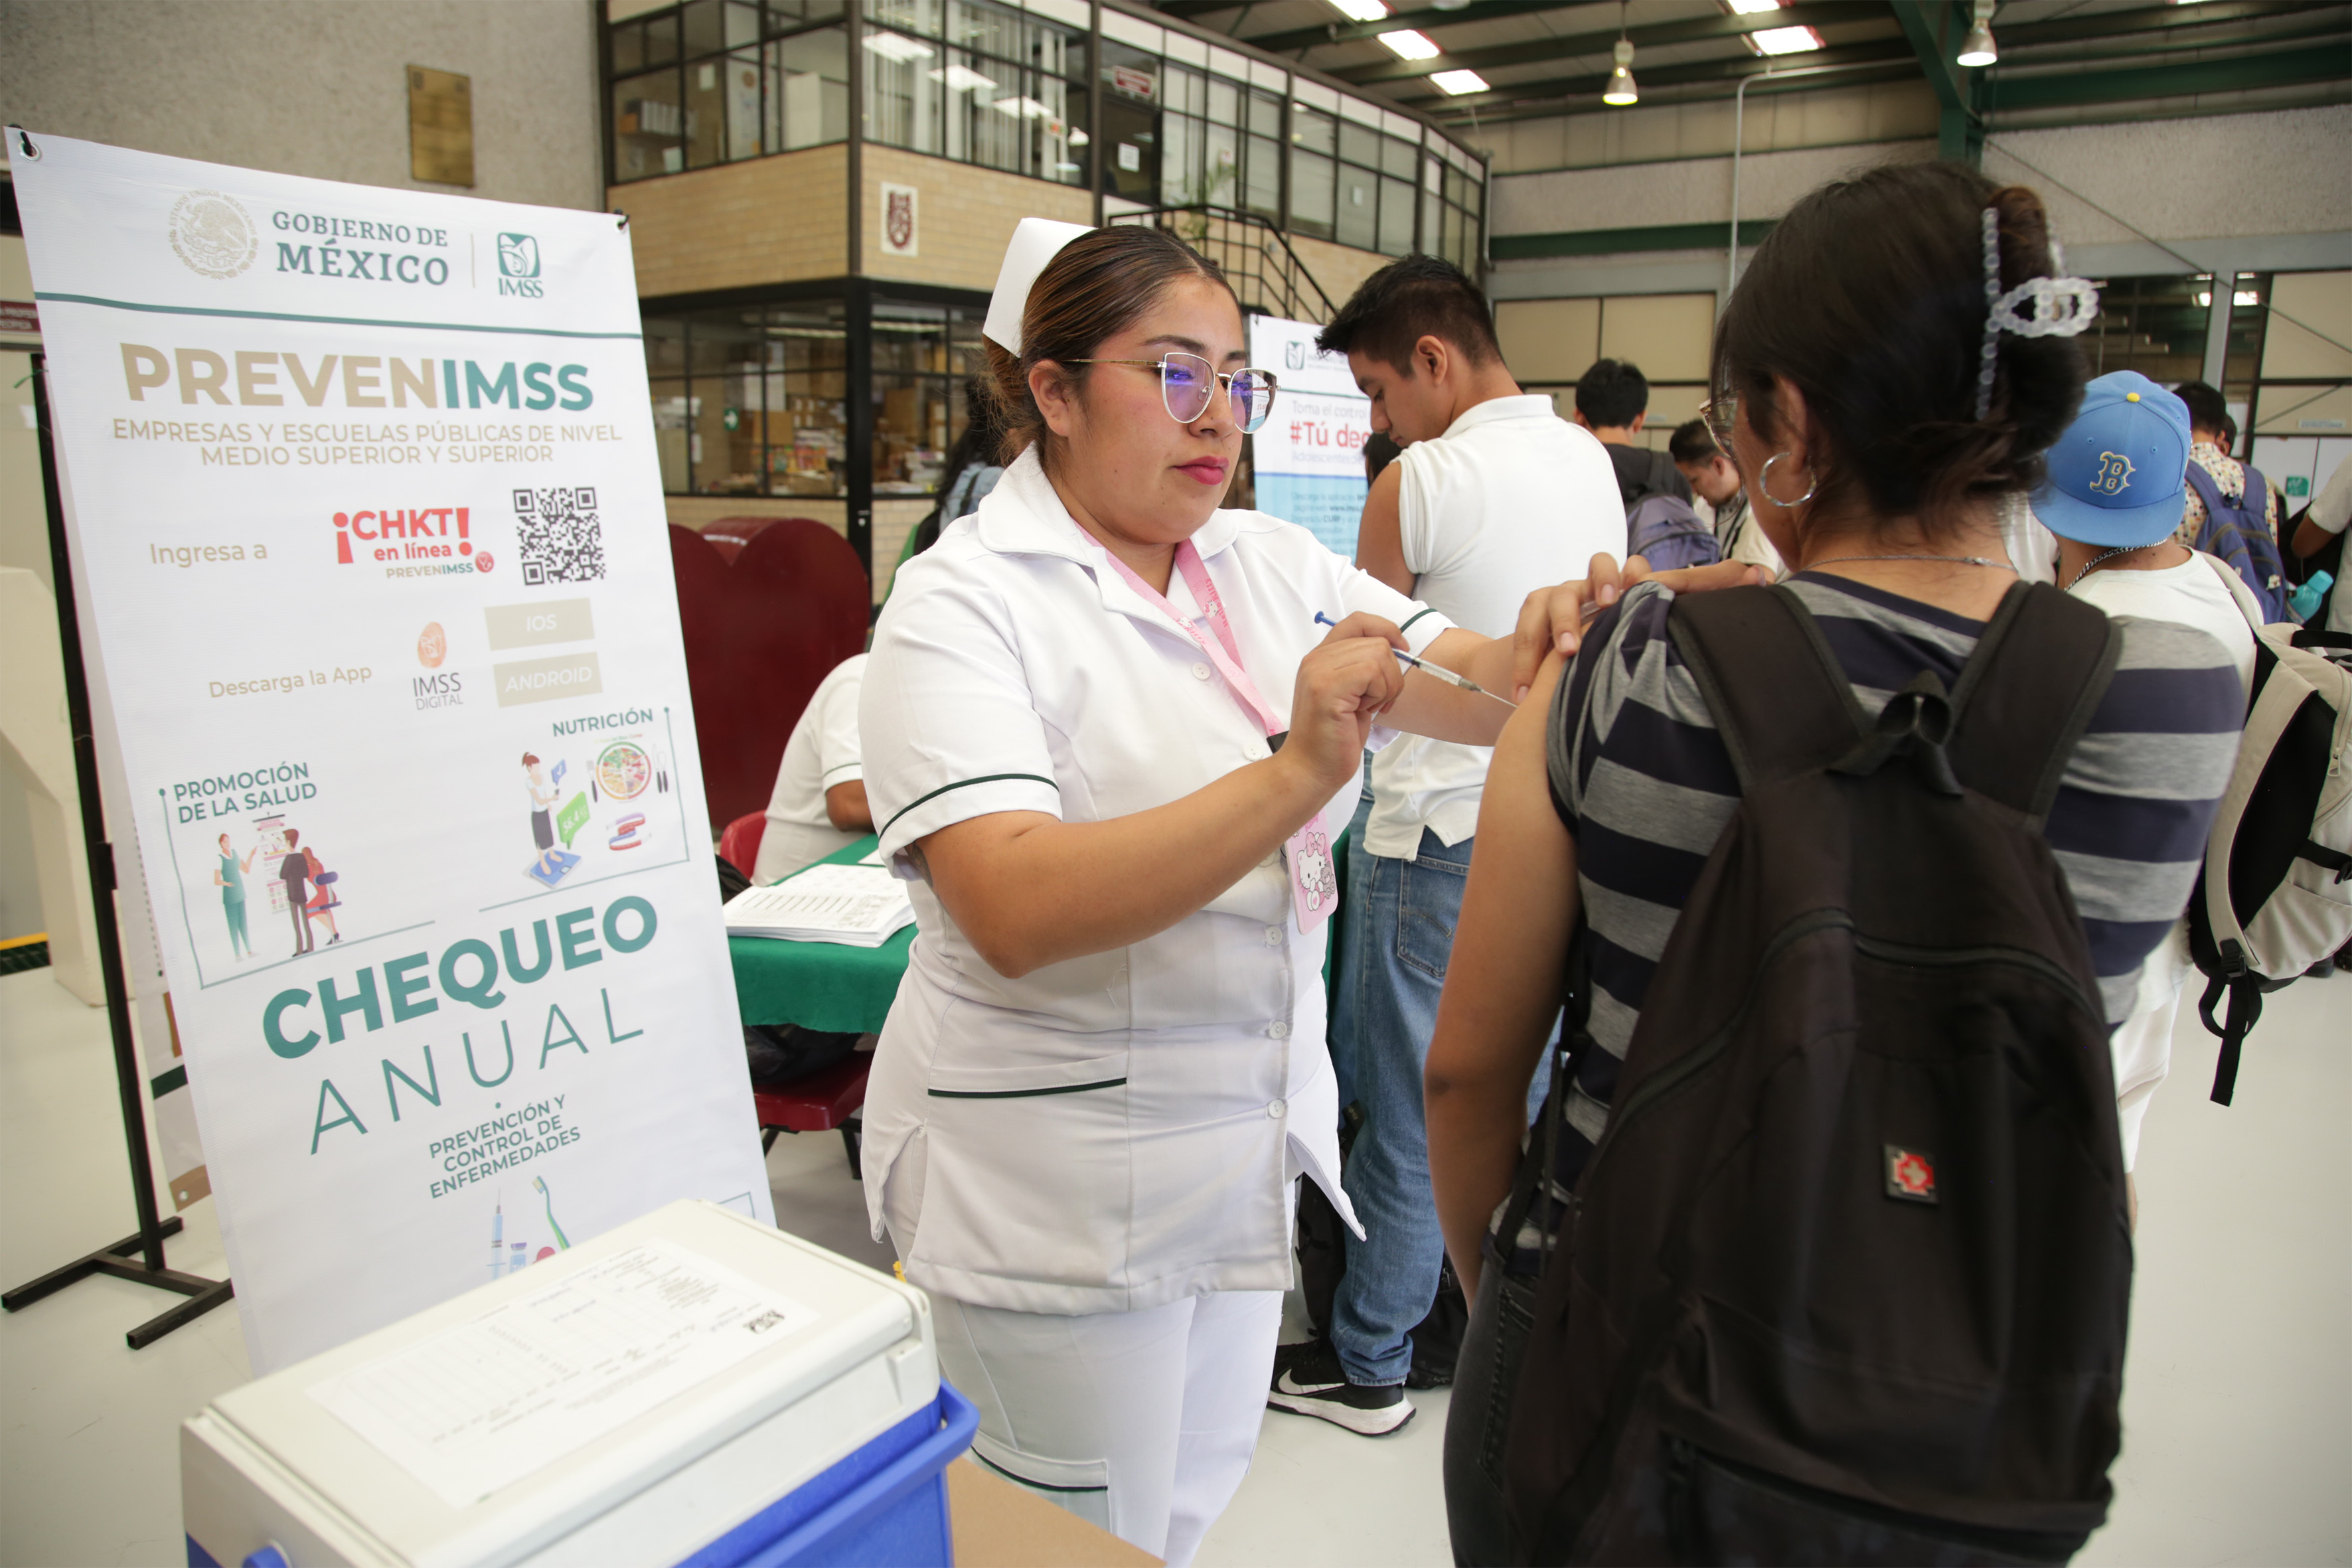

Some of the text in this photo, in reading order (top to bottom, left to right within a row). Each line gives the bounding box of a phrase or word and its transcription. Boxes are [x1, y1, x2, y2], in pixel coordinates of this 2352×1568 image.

[272, 211, 448, 246] GOBIERNO DE
[275, 238, 449, 285] MÉXICO
[499, 278, 544, 298] IMSS
[119, 343, 593, 411] PREVENIMSS
[113, 418, 623, 443] EMPRESAS Y ESCUELAS PÚBLICAS DE NIVEL
[1291, 420, 1328, 446] #Tú
[201, 445, 554, 465] MEDIO SUPERIOR Y SUPERIOR
[2090, 451, 2136, 495] B
[333, 507, 472, 564] ¡CHKT!
[374, 542, 451, 561] en línea
[150, 542, 267, 568] Ingresa a
[386, 563, 473, 578] PREVENIMSS
[526, 614, 557, 631] IOS
[208, 666, 372, 698] Descarga la App
[412, 672, 461, 697] IMSS
[505, 667, 593, 693] ANDROID
[416, 693, 463, 710] DIGITAL
[552, 708, 653, 737] NUTRICIÓN
[174, 761, 309, 801] PROMOCIÓN
[179, 783, 317, 824] DE LA SALUD
[263, 896, 657, 1059] CHEQUEO
[311, 988, 644, 1155] ANUAL
[430, 1094, 566, 1158] PREVENCIÓN Y
[444, 1115, 562, 1172] CONTROL DE
[430, 1127, 581, 1199] ENFERMEDADES
